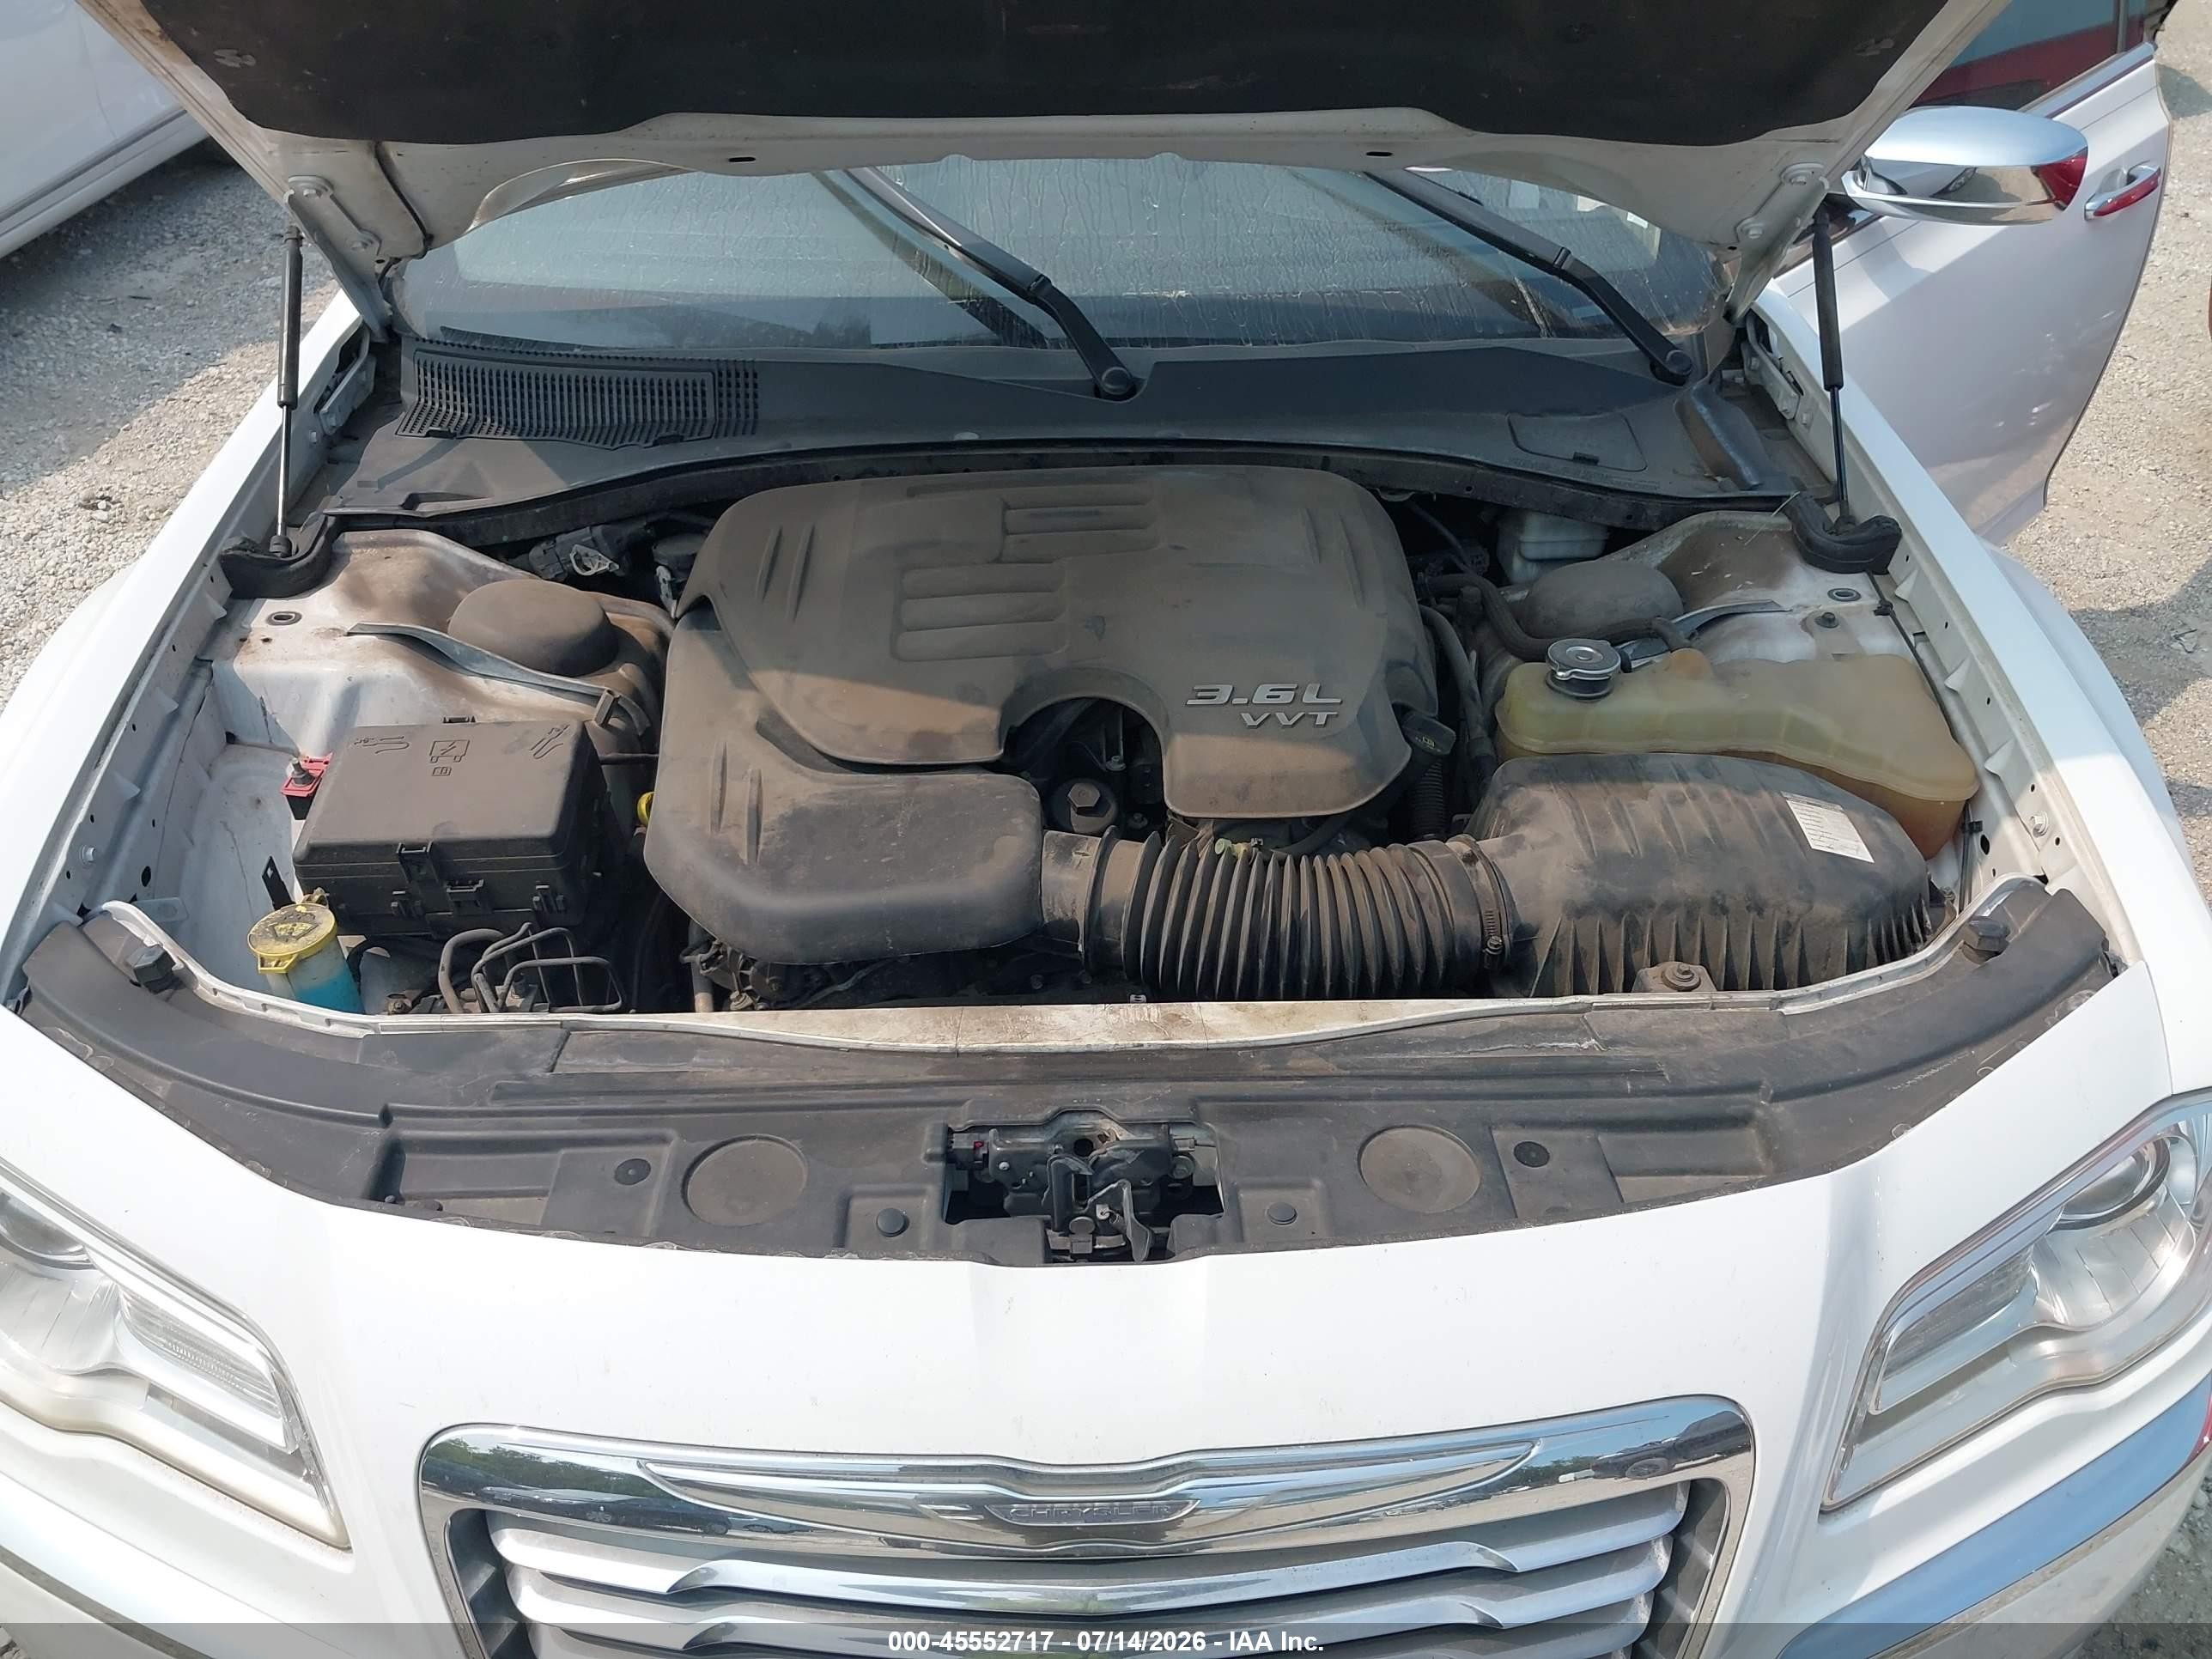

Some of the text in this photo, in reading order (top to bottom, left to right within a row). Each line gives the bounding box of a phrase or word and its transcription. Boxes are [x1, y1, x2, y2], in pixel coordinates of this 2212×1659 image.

[1185, 683, 1343, 707] 3.6L
[1240, 711, 1338, 729] VVT
[1009, 1504, 1171, 1519] CHRYSLER
